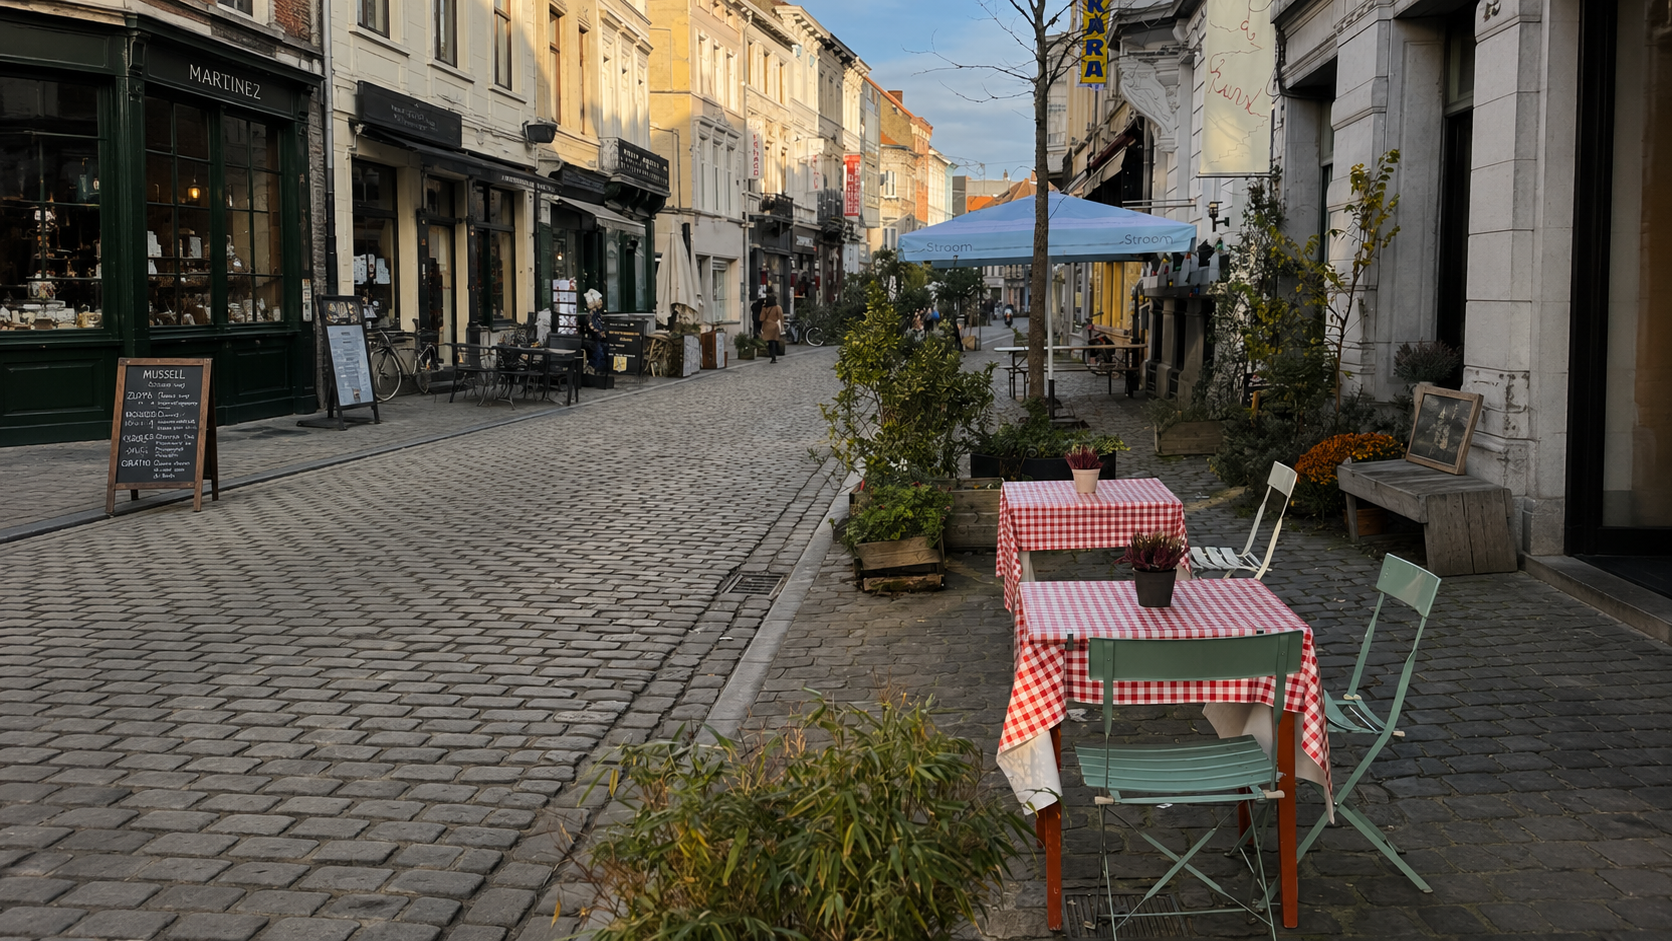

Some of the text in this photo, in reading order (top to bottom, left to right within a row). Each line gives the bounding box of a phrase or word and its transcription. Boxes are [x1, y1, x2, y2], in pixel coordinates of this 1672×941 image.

[1084, 0, 1106, 77] KARA
[189, 63, 261, 100] MARTINEZ
[1124, 233, 1174, 246] Stroom
[926, 241, 973, 253] Stroom
[142, 369, 186, 380] MUSSELL
